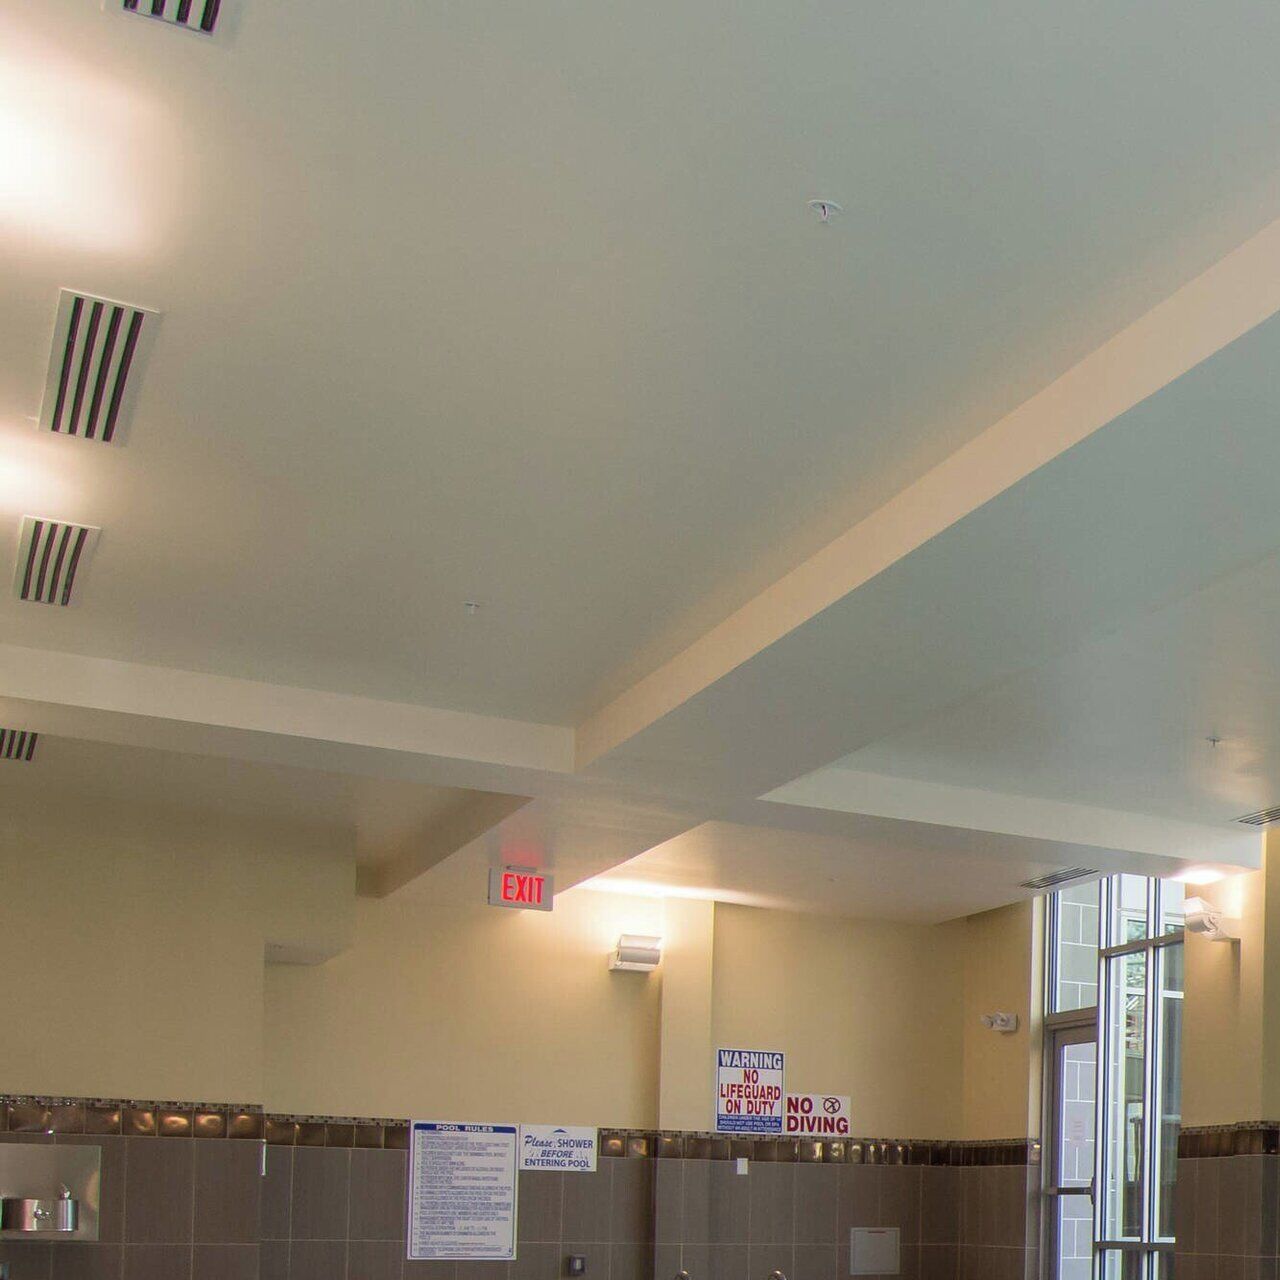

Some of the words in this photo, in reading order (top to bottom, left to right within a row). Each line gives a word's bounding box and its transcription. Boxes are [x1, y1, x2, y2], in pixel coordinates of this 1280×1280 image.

[502, 872, 545, 904] EXIT
[720, 1050, 782, 1069] WARNING
[743, 1069, 759, 1084] NO
[720, 1083, 781, 1101] LIFEGUARD
[726, 1099, 741, 1114] ON
[747, 1100, 775, 1115] DUTY
[787, 1096, 813, 1114] NO
[786, 1115, 849, 1134] DIVING
[524, 1134, 553, 1148] Please
[557, 1138, 593, 1149] SHOWER
[541, 1149, 574, 1158] BEFORE
[525, 1158, 566, 1167] ENTERING
[568, 1159, 591, 1168] POOL
